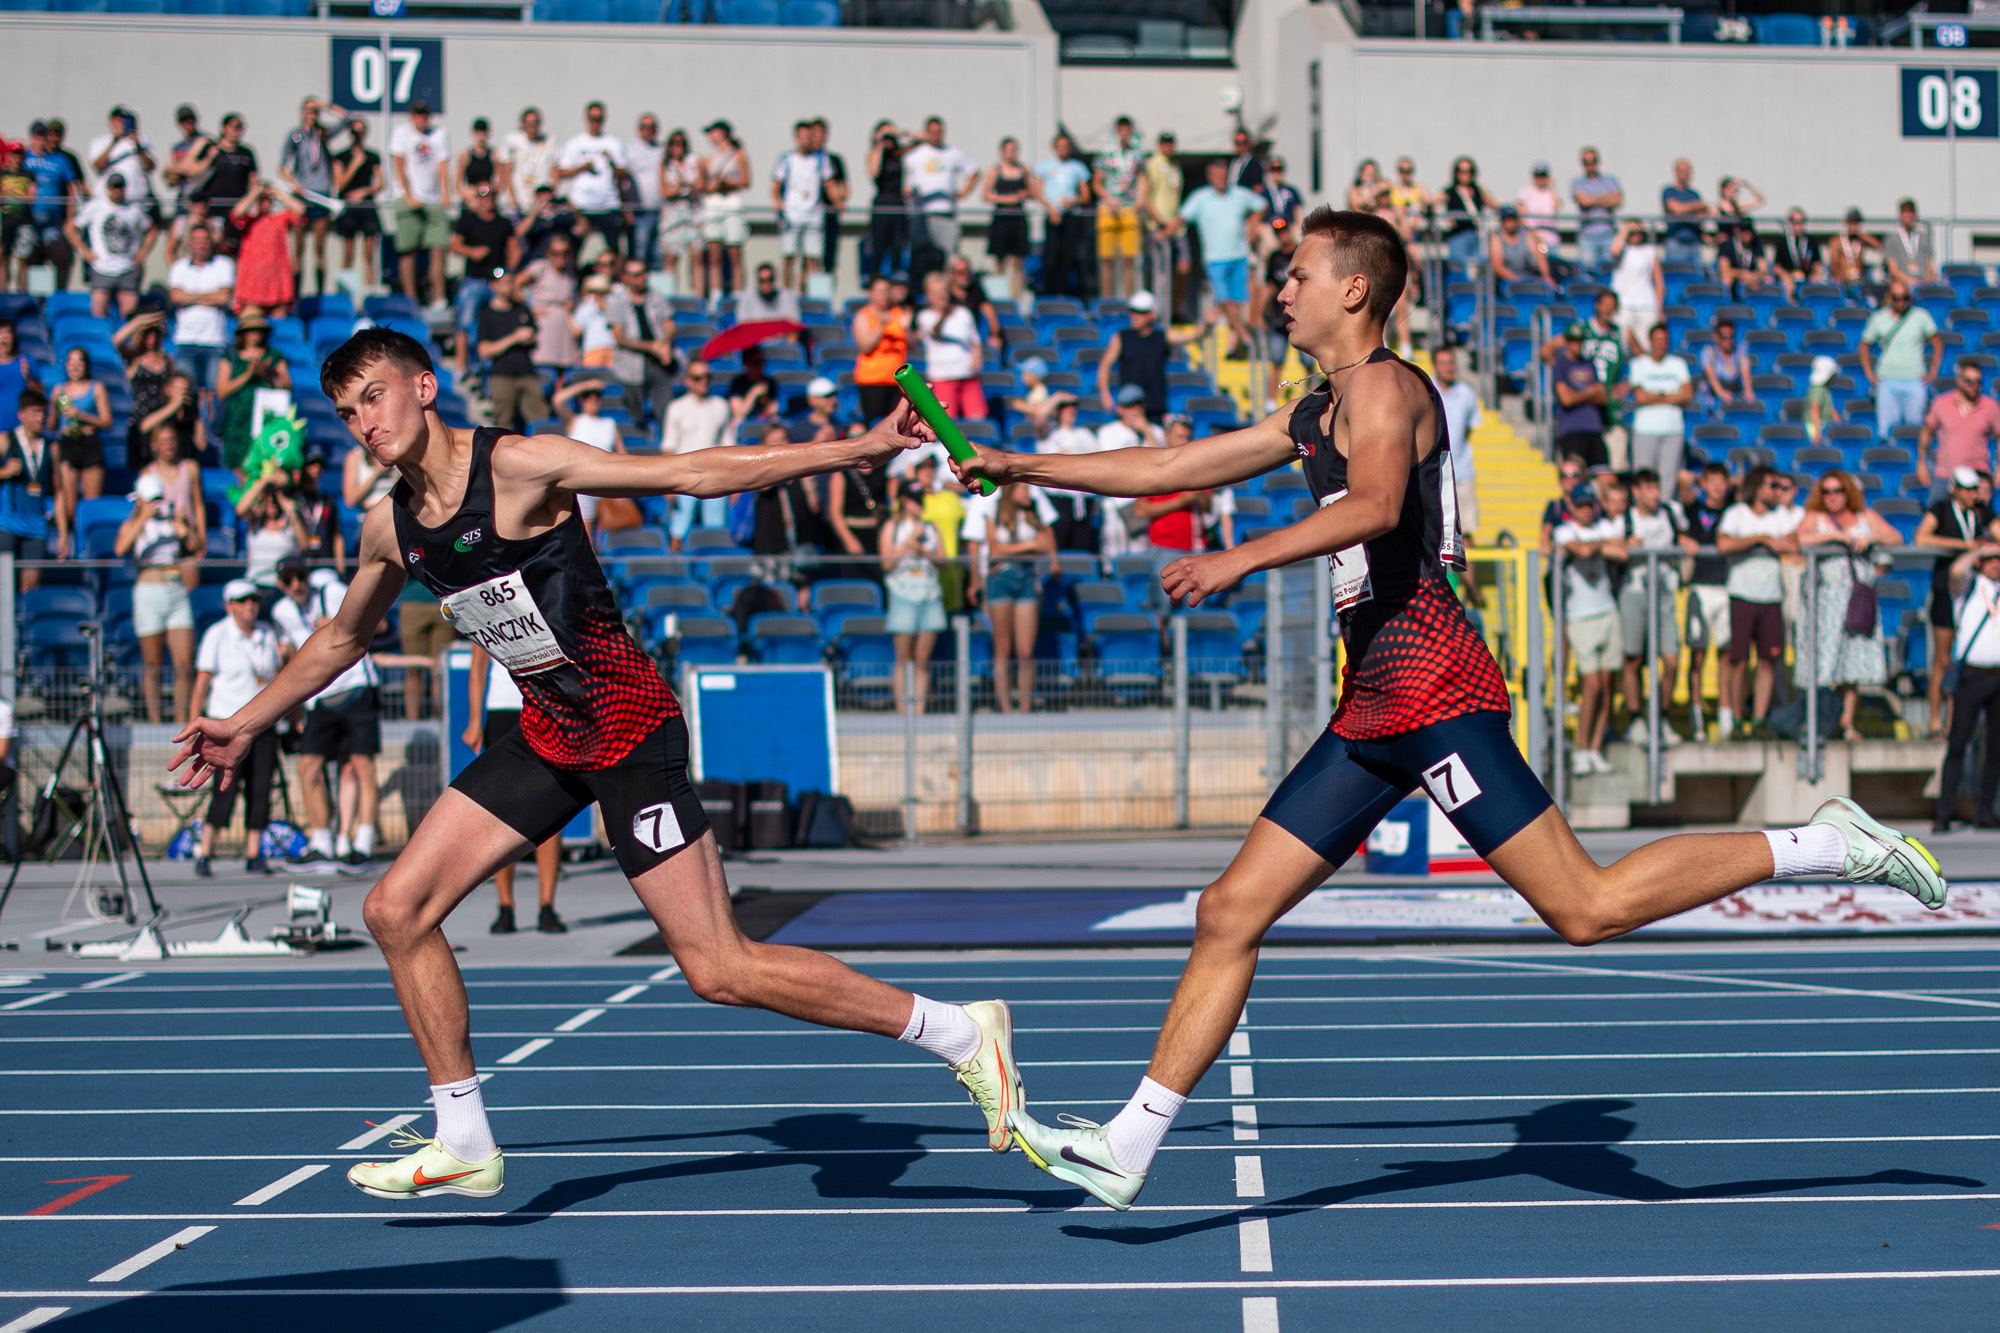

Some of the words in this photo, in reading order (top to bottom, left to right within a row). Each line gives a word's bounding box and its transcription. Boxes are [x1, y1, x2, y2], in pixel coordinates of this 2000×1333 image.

[1936, 25, 1965, 46] 08
[352, 45, 423, 104] 07
[1918, 74, 1982, 130] 08
[462, 528, 481, 544] STS
[479, 580, 516, 607] 865
[465, 612, 545, 649] TAŃCZYK
[1429, 762, 1460, 804] 7
[639, 807, 663, 850] 7
